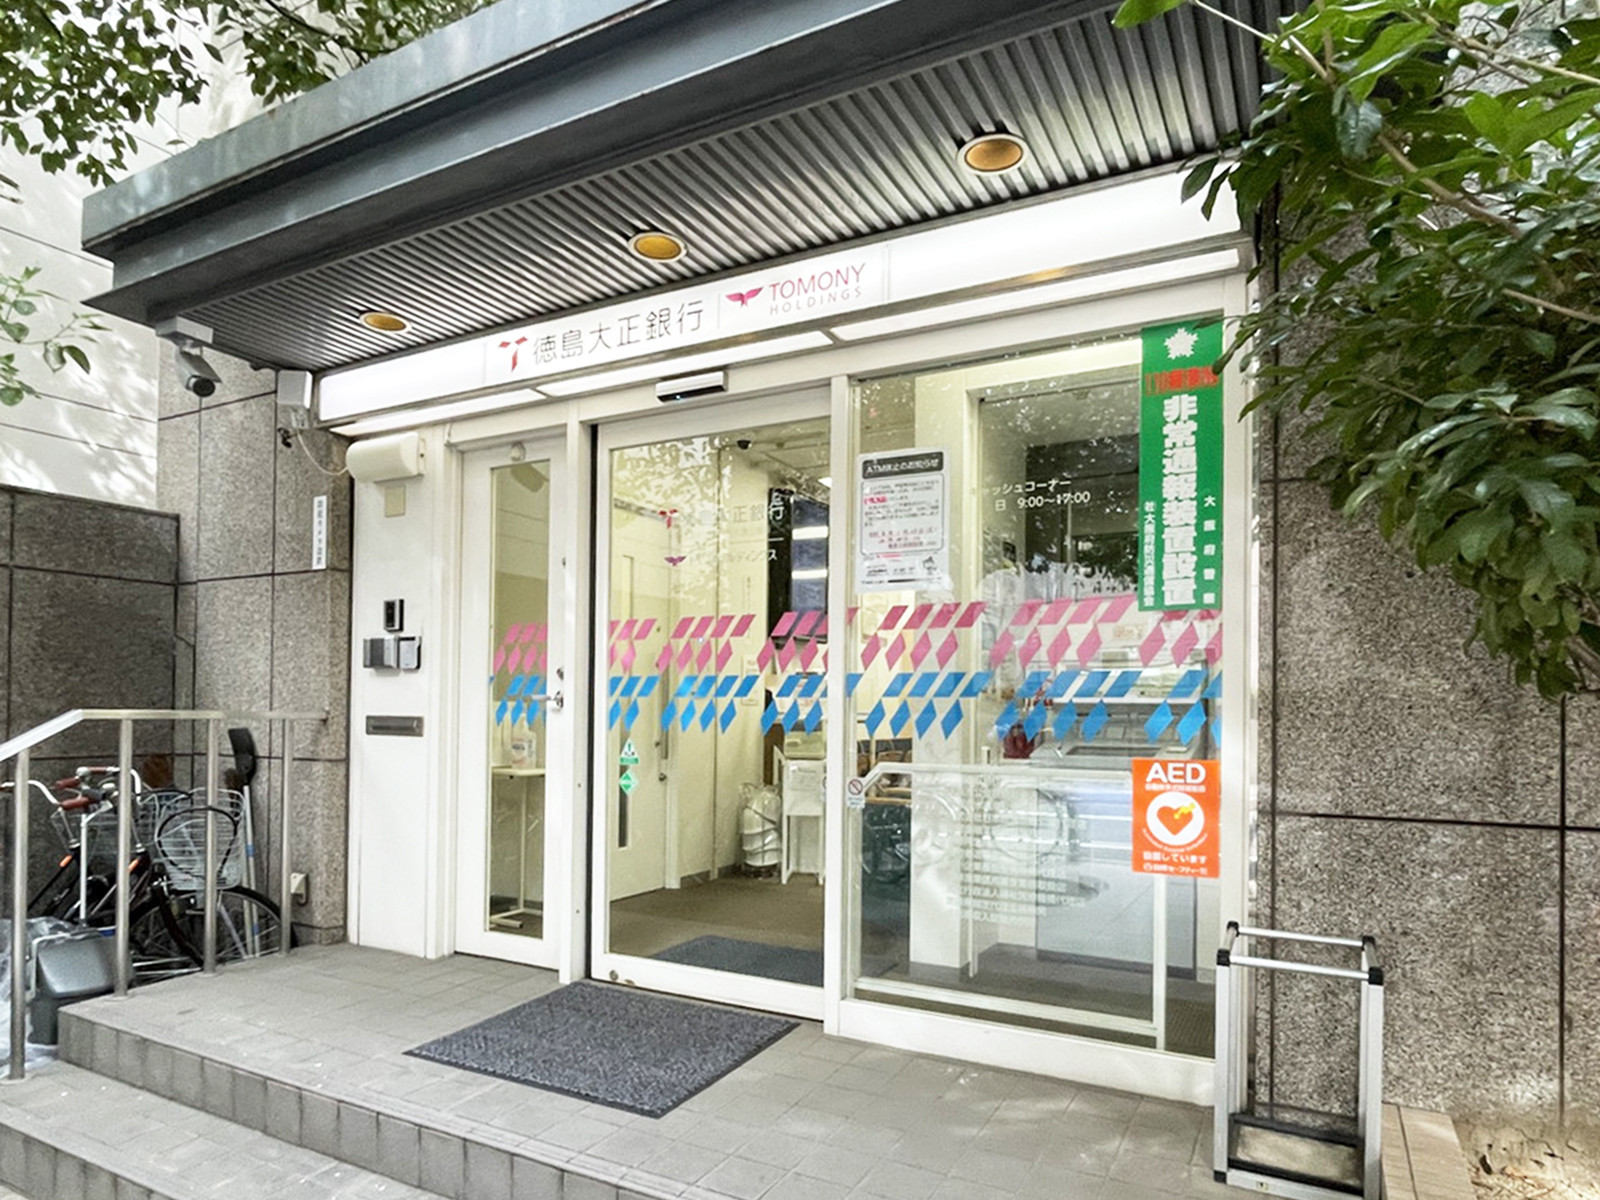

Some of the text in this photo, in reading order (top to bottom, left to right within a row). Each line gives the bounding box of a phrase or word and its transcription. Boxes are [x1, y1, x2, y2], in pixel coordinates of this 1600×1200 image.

[769, 262, 866, 301] TOMONY
[769, 285, 864, 316] HOLDINGS
[533, 300, 704, 365] 徳島大正銀行
[1162, 394, 1197, 606] 非常通報装置設置
[1146, 762, 1206, 784] AED
